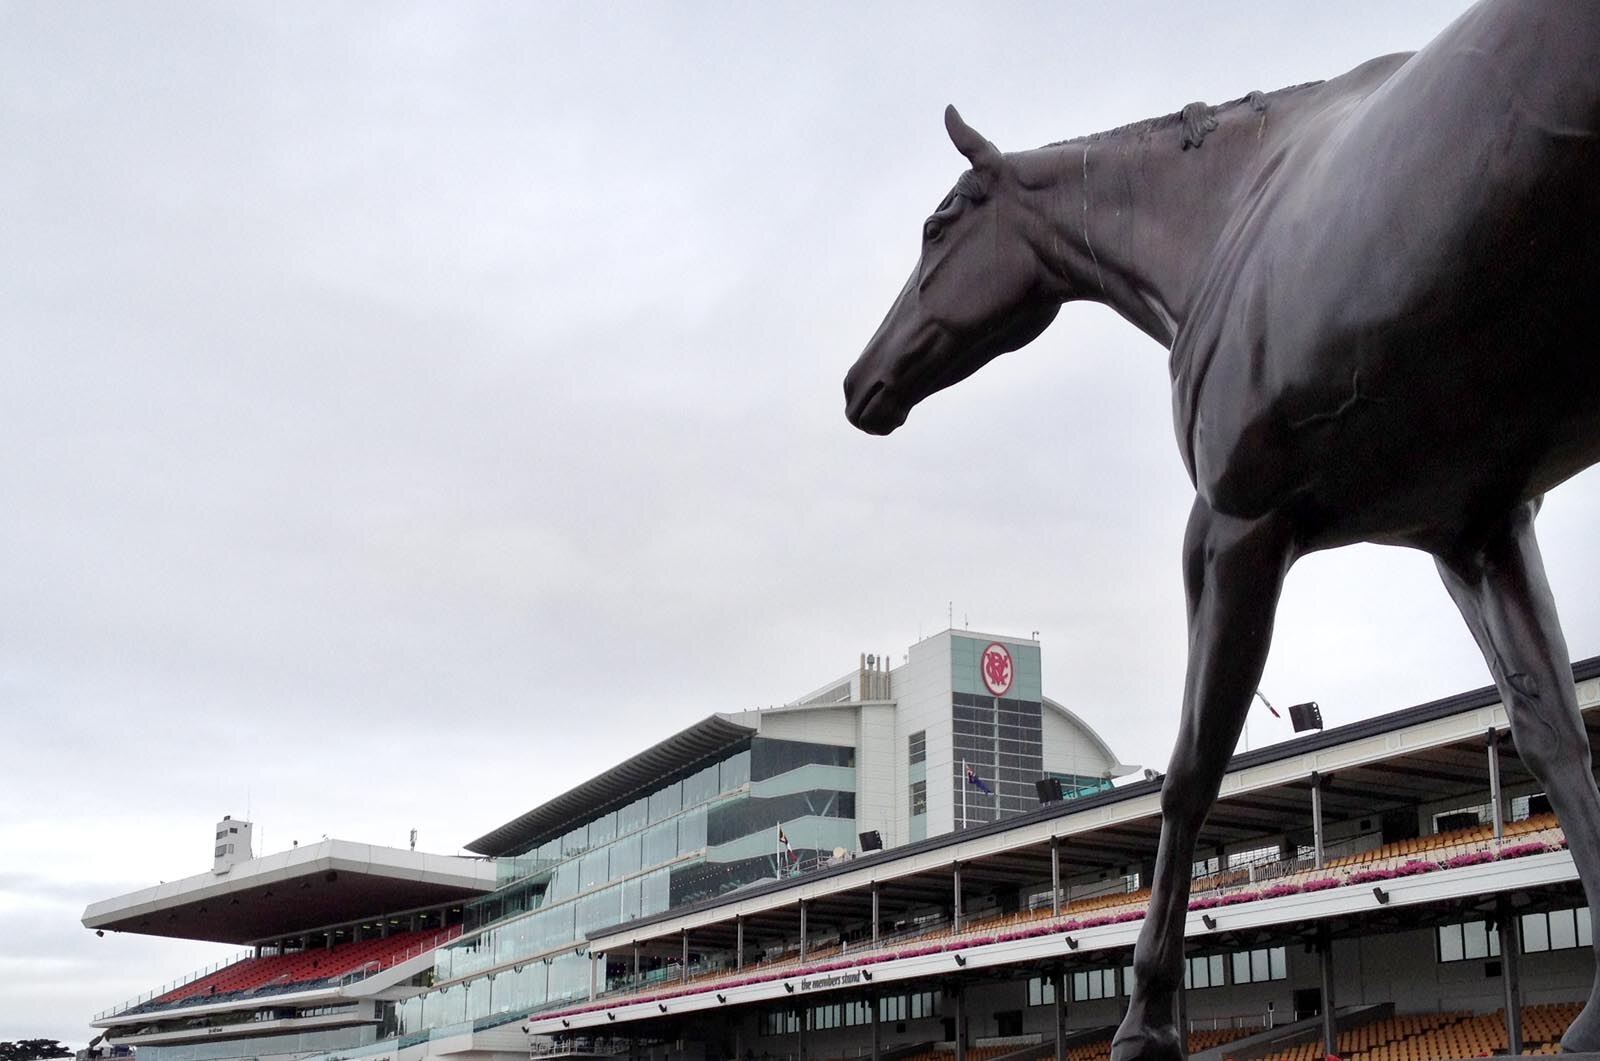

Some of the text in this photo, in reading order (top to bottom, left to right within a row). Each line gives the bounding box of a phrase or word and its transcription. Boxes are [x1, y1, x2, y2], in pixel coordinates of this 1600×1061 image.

[801, 969, 861, 991] the members stand
